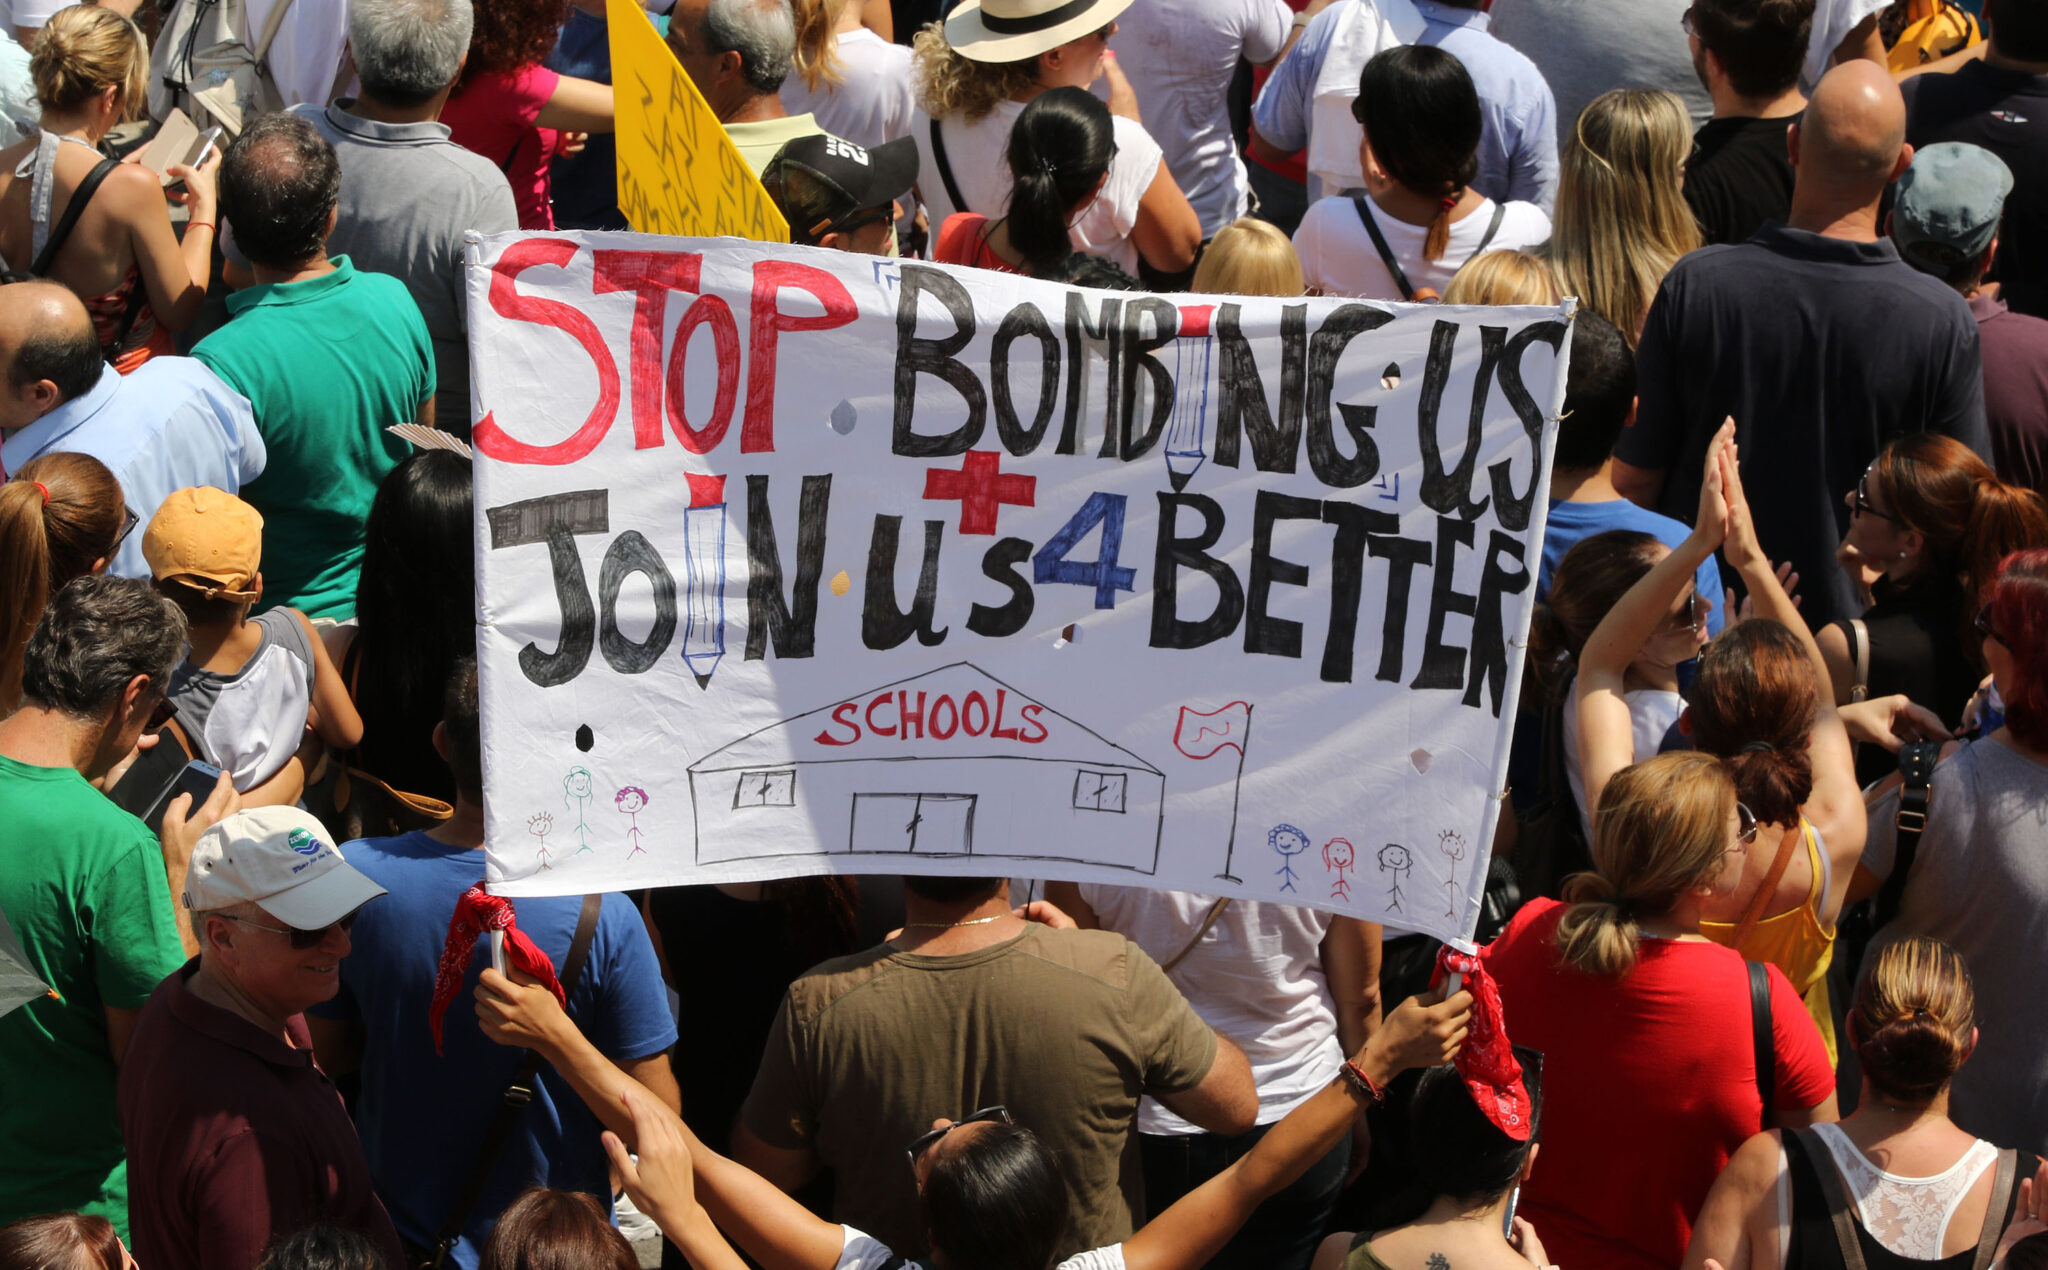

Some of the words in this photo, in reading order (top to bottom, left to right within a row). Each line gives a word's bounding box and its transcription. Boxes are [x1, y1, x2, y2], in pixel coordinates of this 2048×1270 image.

[837, 142, 869, 167] 2
[471, 237, 859, 466] STOP
[892, 264, 1396, 492] BOMBING
[1417, 319, 1570, 532] US
[1034, 491, 1137, 611] 4
[1149, 489, 1532, 719] BETTER
[813, 688, 1049, 746] SCHOOLS
